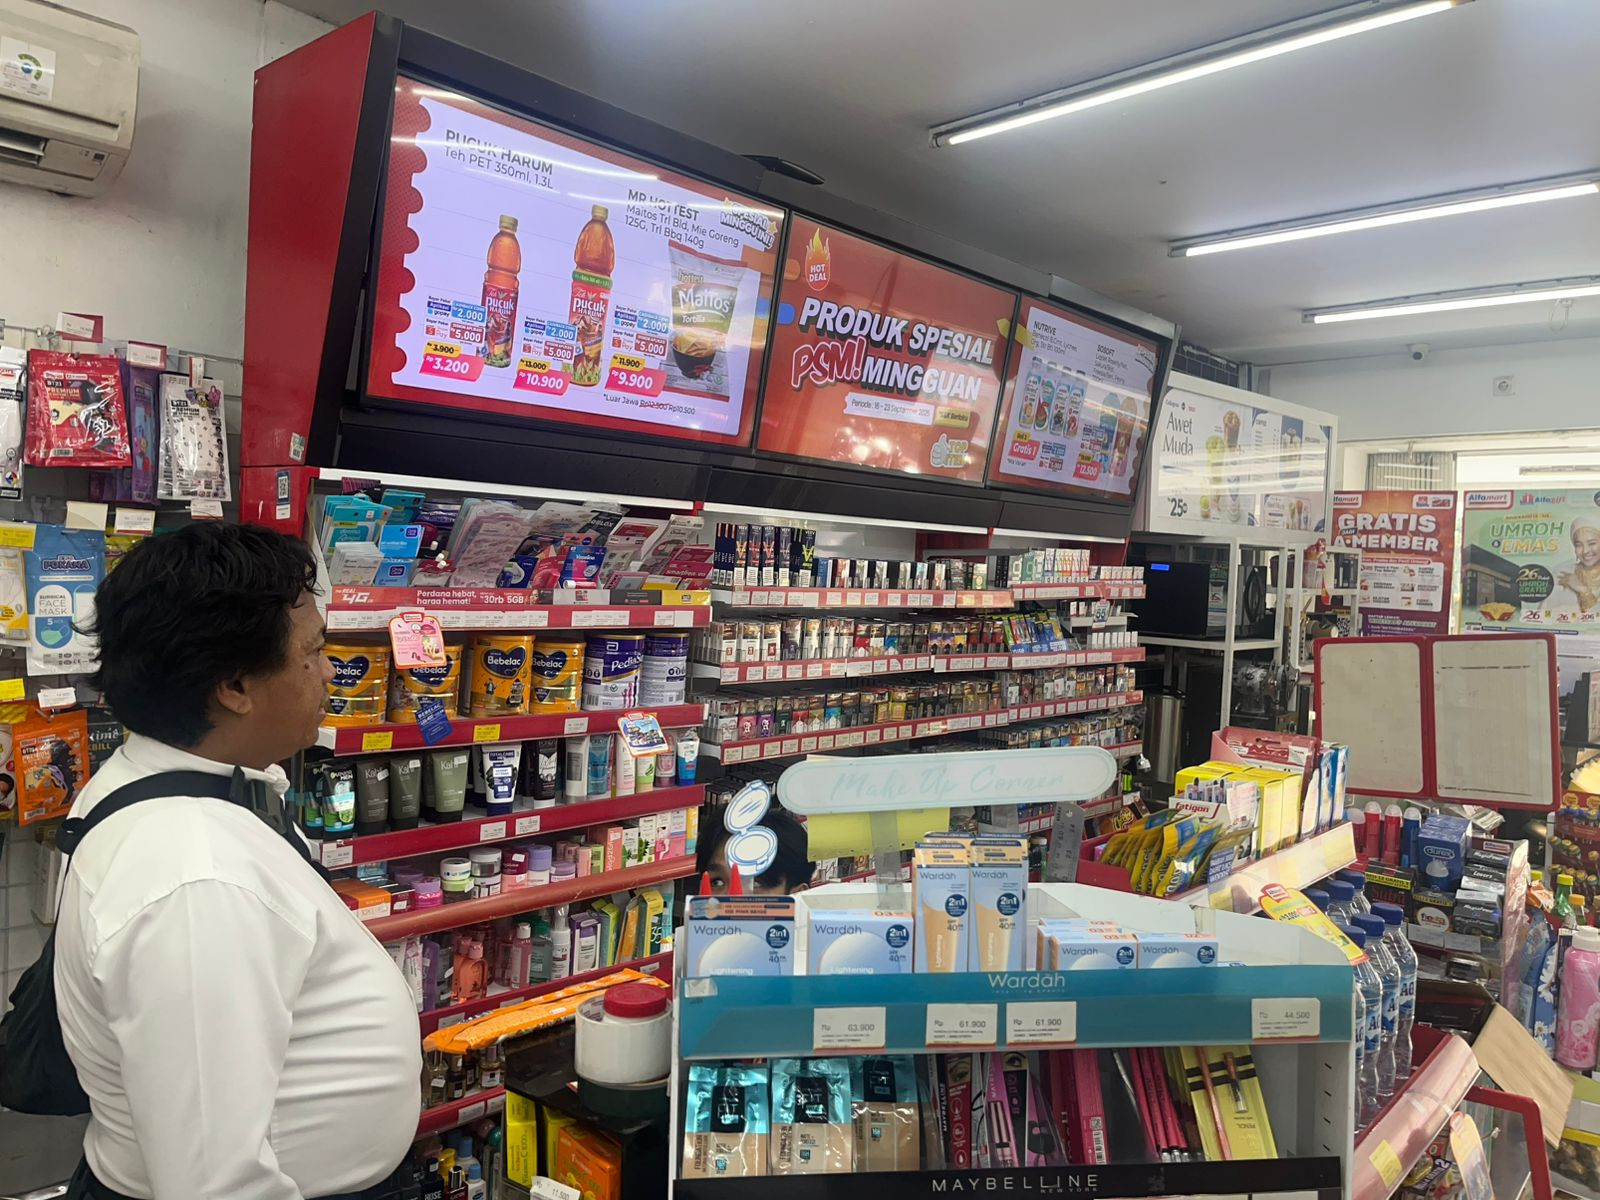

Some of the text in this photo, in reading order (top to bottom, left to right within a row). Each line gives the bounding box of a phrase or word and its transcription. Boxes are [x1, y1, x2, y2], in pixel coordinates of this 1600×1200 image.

[501, 148, 553, 175] HARUM
[444, 146, 553, 189] Teh PET 350ml, 1.3L
[627, 204, 657, 221] Maitos
[708, 230, 739, 247] Goreng
[663, 227, 682, 243] Bbq
[810, 264, 826, 273] HOT
[809, 273, 827, 282] DEAL
[457, 309, 483, 321] 2.000
[642, 317, 667, 332] 2.000
[1033, 321, 1057, 336] NUTRIVE
[456, 329, 481, 342] 5.000
[551, 327, 574, 340] 2.000
[799, 298, 993, 365] PRODUK SPESIAL
[548, 347, 571, 359] 5.000
[640, 342, 664, 355] 5.000
[433, 358, 469, 374] 3.200
[525, 359, 547, 370] 13.000
[619, 357, 641, 368] 11.900
[791, 336, 981, 402] PSM! MINGGUAN
[526, 373, 564, 389] 10.900
[618, 373, 653, 390] 9.900
[1167, 411, 1193, 435] Awet
[1013, 443, 1032, 455] Gratis
[1163, 434, 1194, 457] Muda
[1468, 494, 1508, 502] Alfamart
[1338, 513, 1436, 533] GRATIS
[1491, 522, 1564, 537] UMROH
[1502, 539, 1559, 553] EMAS
[1516, 568, 1538, 583] 26
[342, 593, 370, 604] 4G
[417, 590, 477, 599] Perdana hebat,
[484, 595, 524, 604] 30rb 5GB
[39, 600, 67, 608] FACE
[47, 618, 53, 626] 5
[487, 656, 521, 666] Bebelac
[831, 764, 1064, 800] Make Up Corner
[1175, 802, 1210, 813] fatigon
[920, 872, 957, 880] Wardah
[971, 870, 1008, 879] Wardah
[948, 898, 965, 906] 2in1
[1000, 896, 1017, 904] 2in1
[694, 925, 742, 935] Wardah
[769, 929, 787, 937] 2in1
[815, 924, 862, 935] Wardah
[889, 928, 907, 937] 2in1
[1062, 947, 1099, 956] Wardah
[1142, 946, 1180, 954] Wardah
[769, 955, 780, 963] 40
[988, 972, 1066, 988] Wardah
[1284, 1011, 1311, 1019] 44.500
[821, 1023, 875, 1032] Rp 63.900
[934, 1019, 986, 1028] Rp 61.900
[1013, 1018, 1062, 1027] Rp 61.900
[932, 1174, 1098, 1192] MAYBELLINE
[552, 1188, 570, 1200] 11.500
